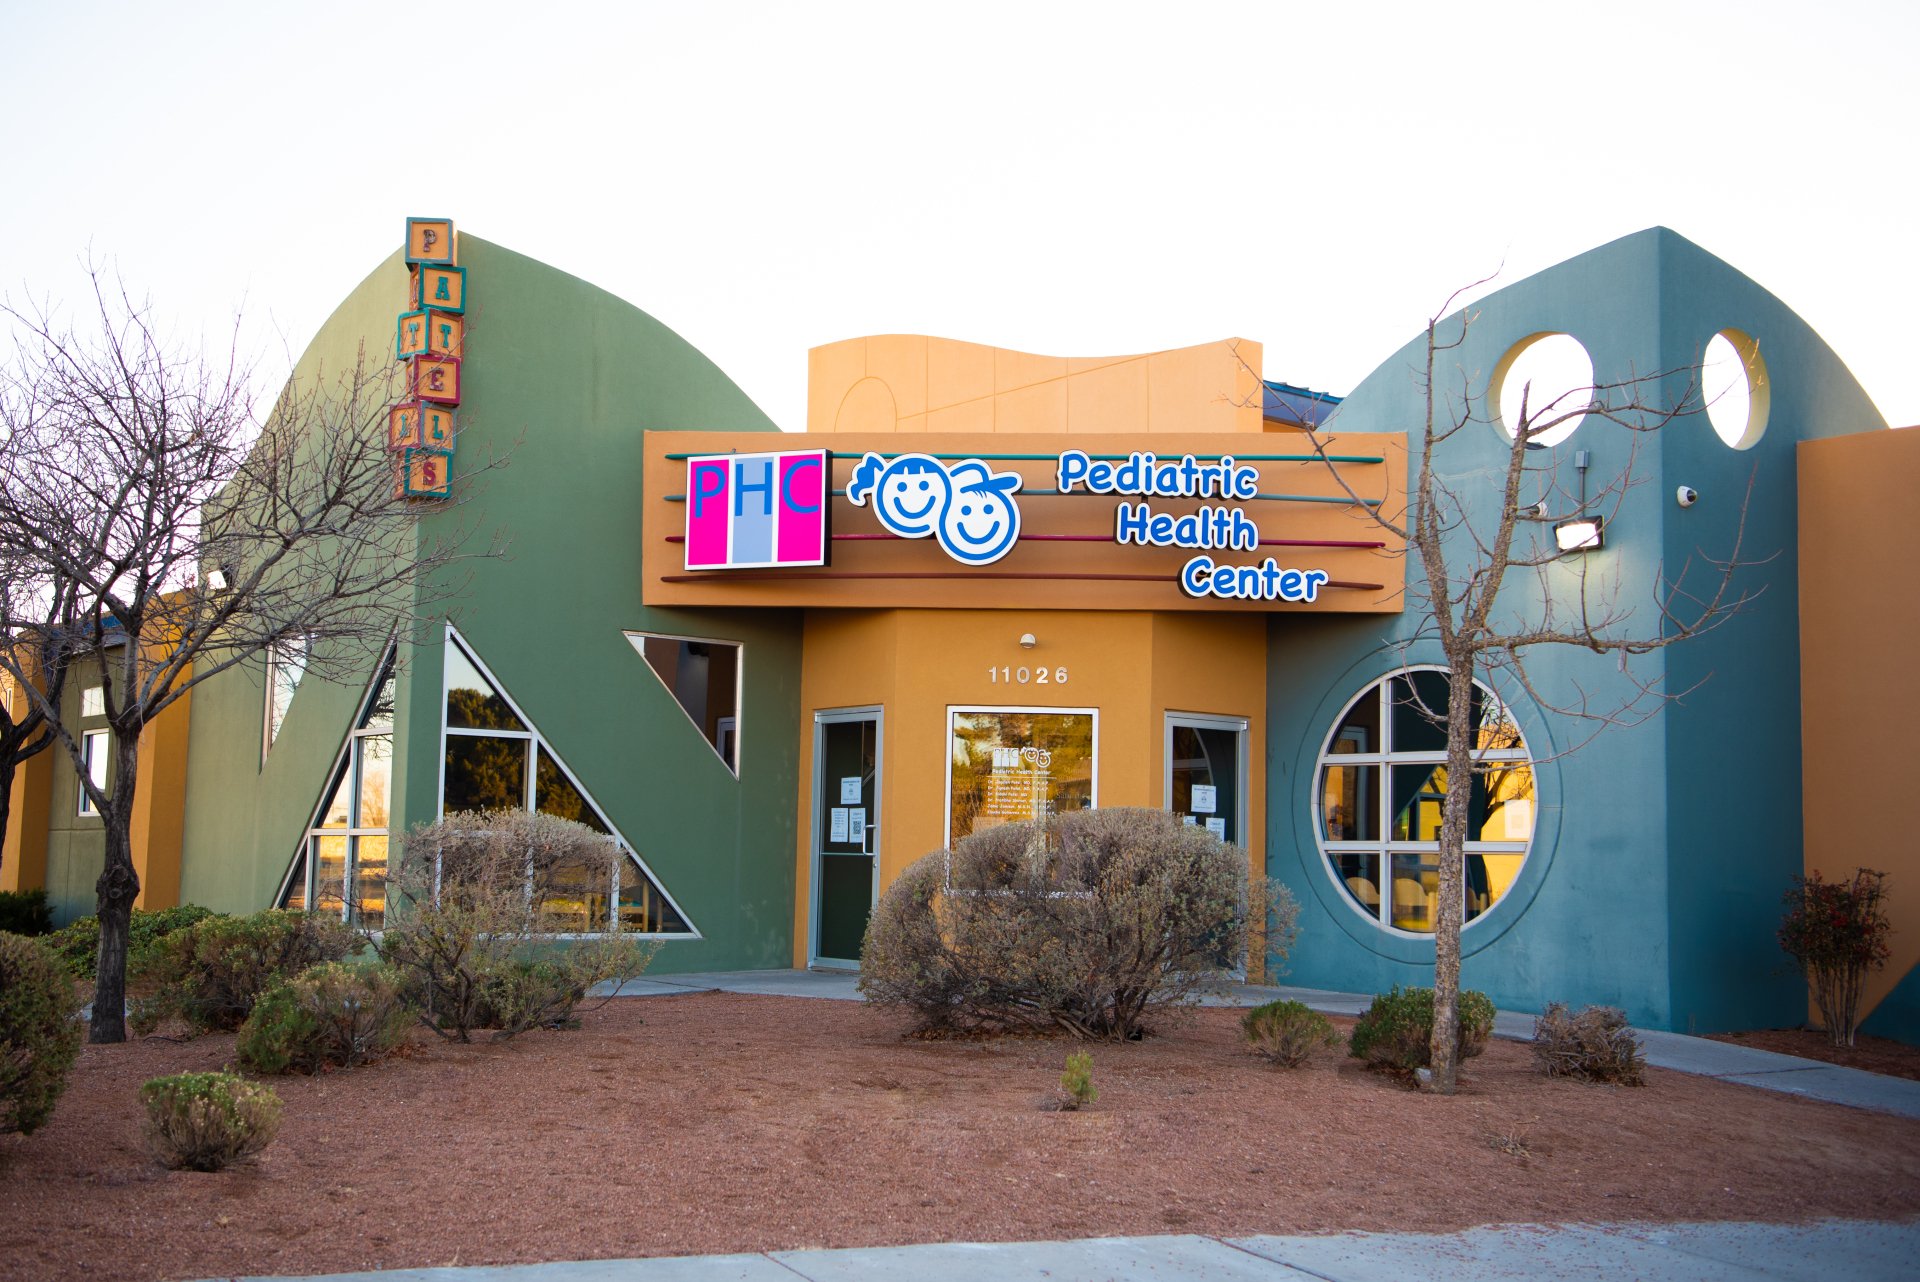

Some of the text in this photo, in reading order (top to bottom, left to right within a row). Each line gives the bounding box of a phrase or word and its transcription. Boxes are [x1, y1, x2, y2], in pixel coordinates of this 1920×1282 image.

[694, 459, 821, 518] PHC
[1060, 452, 1257, 497] Pediatric
[1119, 504, 1256, 549] Health
[1184, 557, 1326, 600] Center
[988, 666, 1068, 684] 11026
